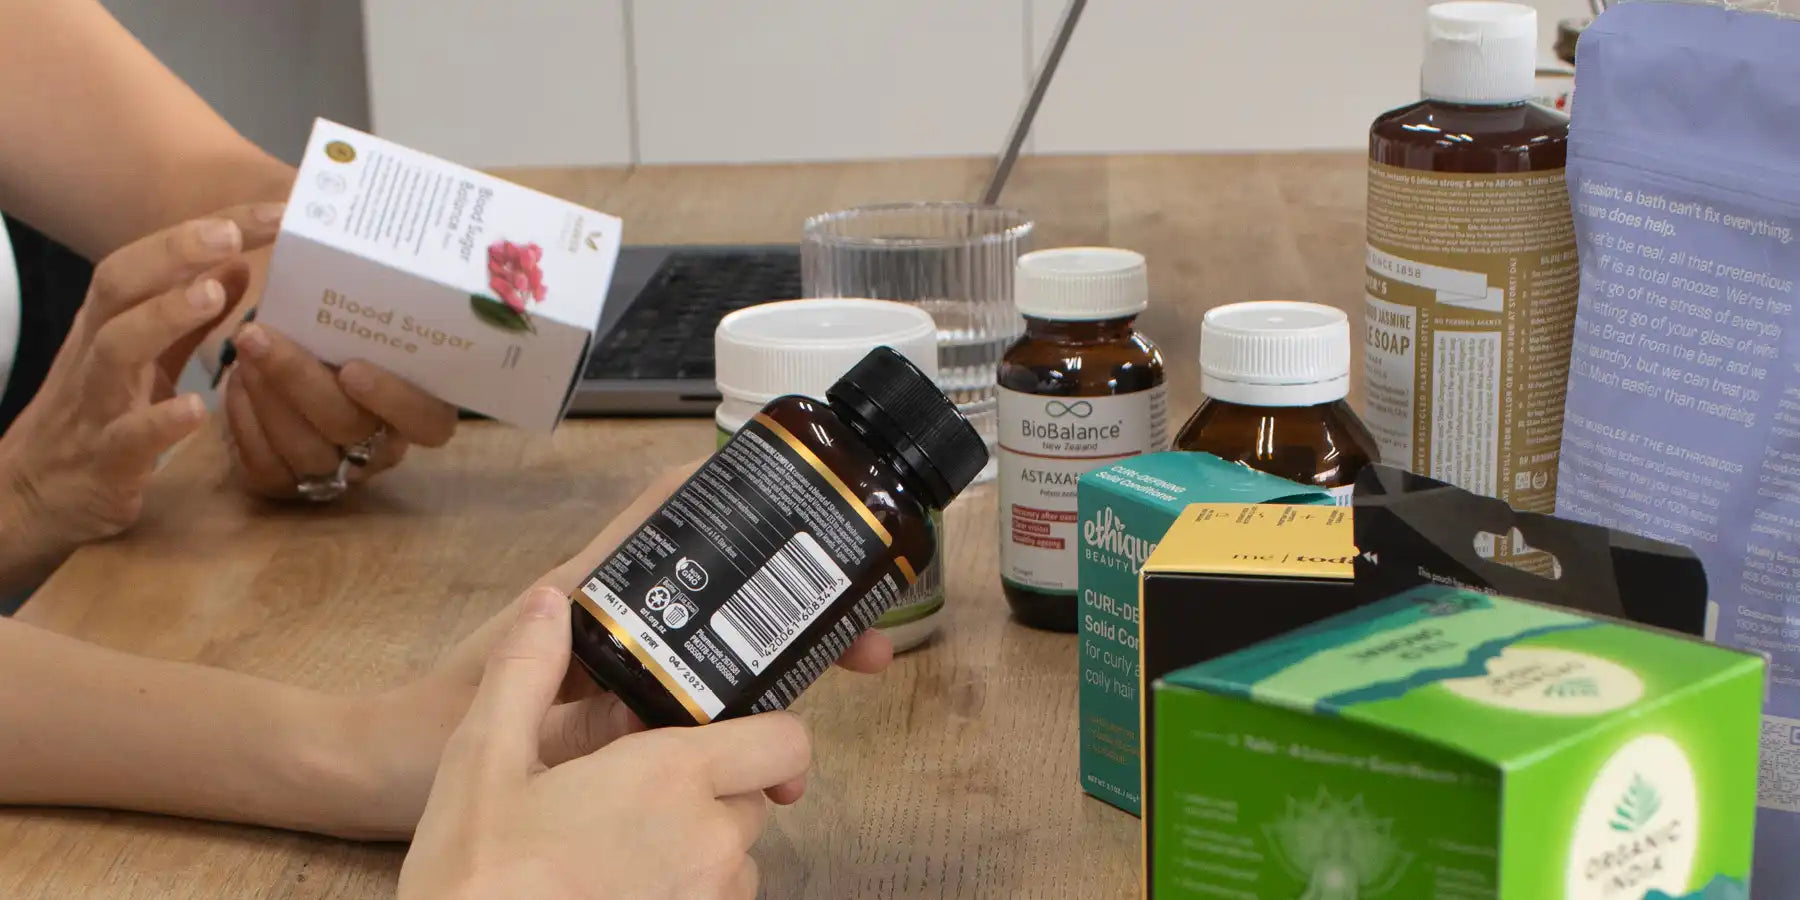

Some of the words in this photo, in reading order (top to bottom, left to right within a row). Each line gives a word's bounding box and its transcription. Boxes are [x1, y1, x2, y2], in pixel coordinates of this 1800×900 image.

[1440, 179, 1465, 189] strong
[1607, 206, 1643, 229] does
[1643, 215, 1678, 238] help.
[1635, 190, 1668, 211] bath
[1668, 198, 1703, 220] can't
[1703, 206, 1721, 224] fix
[1722, 211, 1795, 245] everything.
[1395, 263, 1421, 279] 1858
[1615, 236, 1635, 254] be
[1635, 242, 1667, 263] real,
[1668, 249, 1686, 266] all
[1687, 253, 1715, 274] that
[1715, 262, 1792, 293] pretentious
[1605, 282, 1625, 300] go
[1626, 285, 1644, 301] of
[1644, 290, 1668, 308] the
[1669, 298, 1713, 320] stress
[1714, 307, 1732, 325] of
[1729, 314, 1783, 341] everyday
[1637, 265, 1670, 285] total
[1670, 275, 1721, 299] snooze.
[1725, 287, 1766, 310] We're
[1765, 297, 1795, 317] here
[315, 307, 419, 354] Balance
[320, 287, 394, 325] Blood
[399, 313, 476, 356] Sugar
[1378, 307, 1411, 330] JASMINE
[1627, 311, 1647, 330] go
[1649, 314, 1667, 331] of
[1665, 320, 1699, 342] your
[1698, 329, 1736, 352] glass
[1735, 337, 1754, 354] of
[1374, 322, 1411, 358] SOAP
[1506, 348, 1514, 373] FROM
[1601, 324, 1635, 346] Brad
[1637, 334, 1672, 355] from
[1671, 343, 1696, 363] the
[1696, 350, 1725, 370] bar,
[1726, 358, 1751, 376] and
[1750, 366, 1767, 380] we
[1419, 351, 1427, 390] PLASTIC
[1587, 364, 1621, 388] Much
[1620, 376, 1662, 399] easier
[1663, 387, 1697, 409] than
[1635, 357, 1659, 375] but
[1660, 366, 1680, 381] we
[1682, 372, 1711, 390] can
[1711, 379, 1743, 399] treat
[1740, 388, 1761, 405] you
[1504, 390, 1513, 424] GALLON
[1042, 442, 1060, 450] New
[1064, 442, 1098, 451] Zealand
[1583, 419, 1627, 441] MUSCLES
[1628, 432, 1642, 445] AT
[1642, 437, 1666, 453] THE
[1665, 445, 1722, 469] BATHROOM
[768, 492, 780, 503] and
[772, 451, 795, 472] COMPLEX
[791, 469, 811, 488] contains
[810, 487, 826, 503] blend
[843, 520, 858, 537] Reishi
[854, 532, 866, 544] and
[1095, 471, 1121, 483] Solid
[1120, 479, 1178, 501] Conditioner
[777, 490, 797, 508] support
[792, 505, 811, 523] healthy
[807, 520, 824, 538] energy
[821, 534, 838, 551] levels.
[836, 551, 850, 565] great
[790, 491, 804, 504] used
[804, 505, 828, 528] traditional
[825, 526, 844, 545] Chinese
[839, 542, 858, 561] practice
[803, 492, 814, 503] and
[810, 500, 829, 518] Vitamin
[836, 527, 854, 546] support
[850, 541, 868, 560] healthy
[680, 568, 699, 587] GMO
[688, 567, 703, 581] NON
[1085, 548, 1129, 572] BEAUTY
[662, 579, 677, 594] Bottle
[763, 620, 800, 658] 420061
[799, 583, 838, 622] 608341
[1084, 615, 1115, 640] Solid
[603, 592, 628, 616] M4113
[639, 631, 659, 651] EXPIRY
[667, 654, 705, 693] 04/2027
[695, 628, 725, 660] Pharmacode
[721, 655, 741, 676] 2671581
[1086, 640, 1100, 660] for
[1103, 650, 1133, 677] curly
[1085, 668, 1110, 694] coily
[1113, 678, 1136, 701] hair
